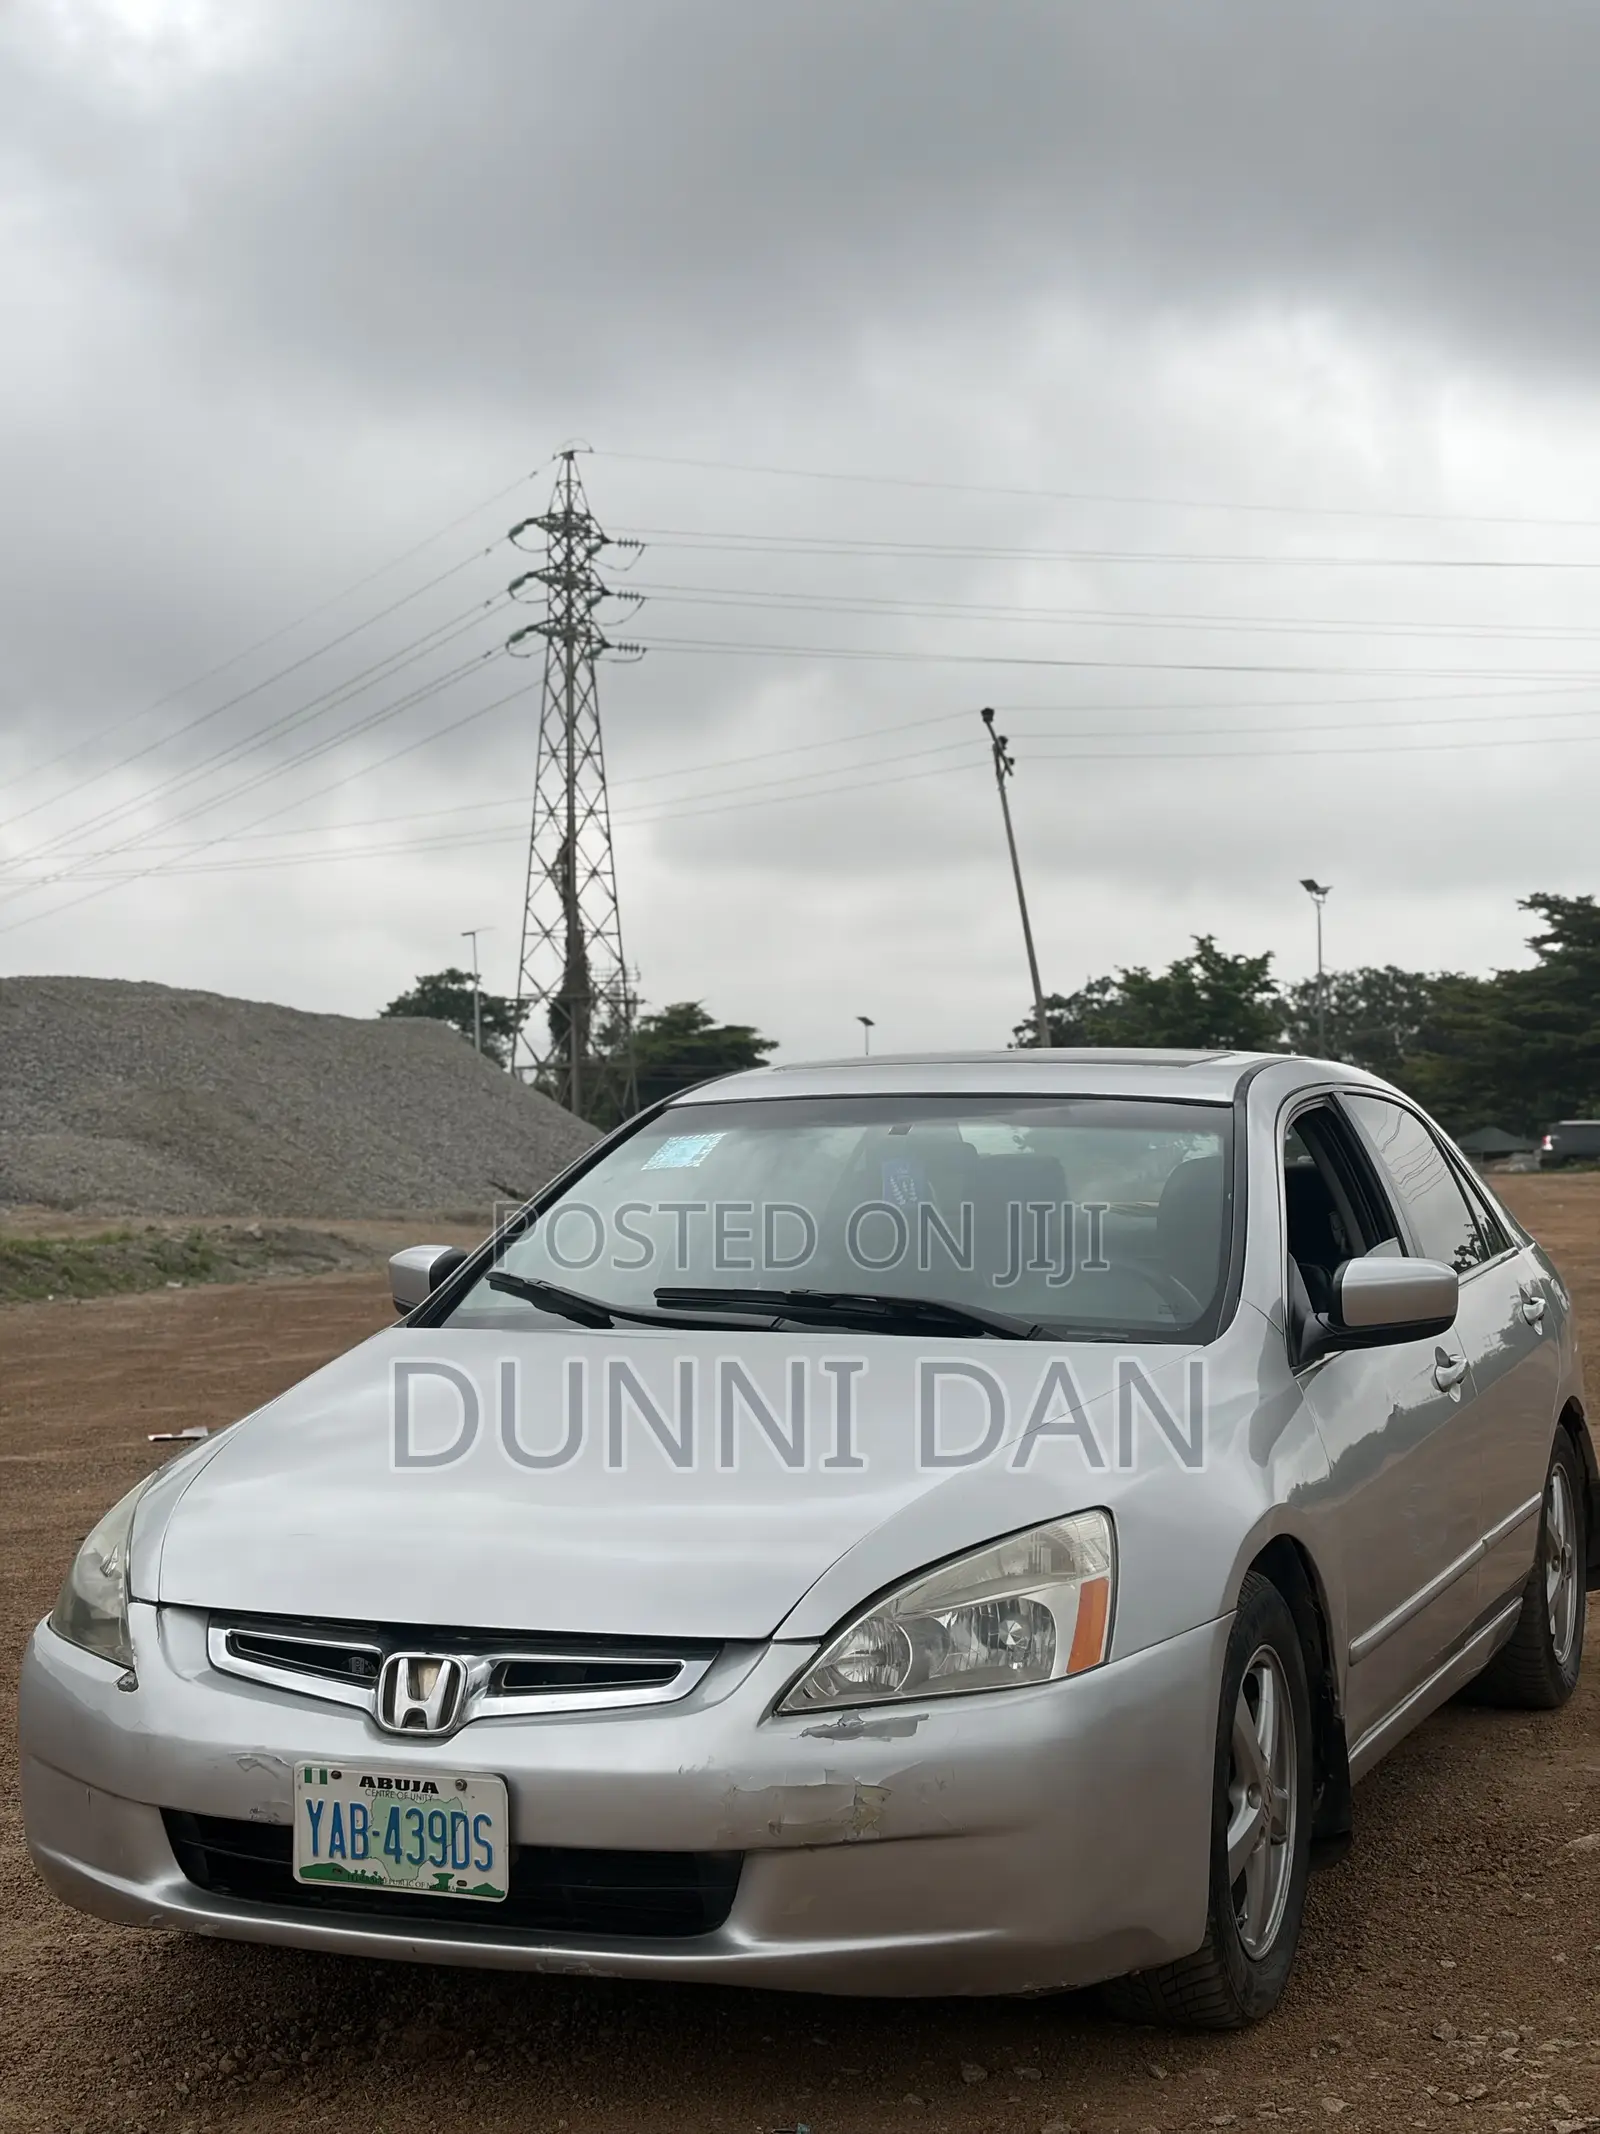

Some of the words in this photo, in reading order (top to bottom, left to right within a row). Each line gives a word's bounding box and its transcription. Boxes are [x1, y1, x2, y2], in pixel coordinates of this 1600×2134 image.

[359, 1775, 439, 1795] ABUJA
[365, 1788, 395, 1799] CENTRE
[396, 1791, 408, 1800] OF
[411, 1793, 434, 1802] UNITY
[305, 1799, 493, 1872] YAB-439DS
